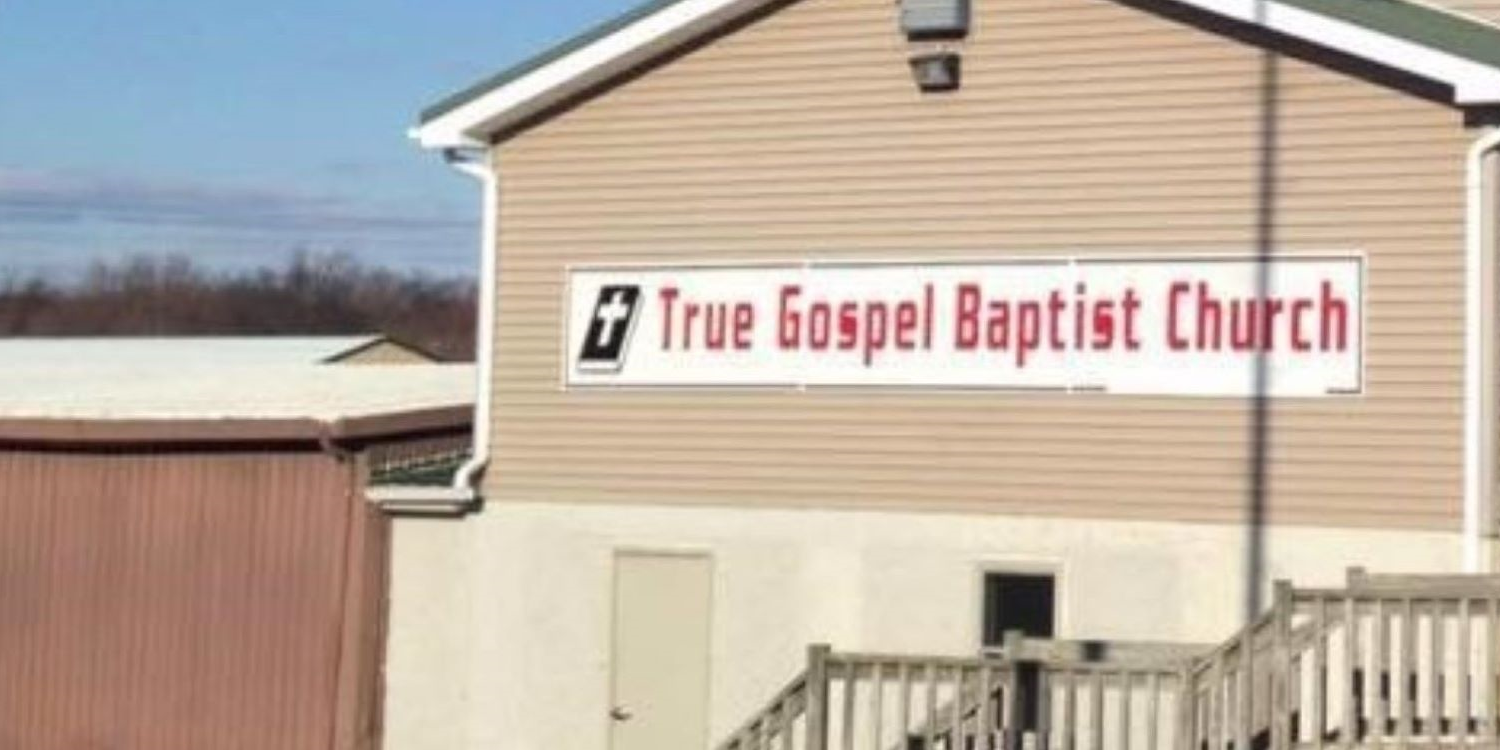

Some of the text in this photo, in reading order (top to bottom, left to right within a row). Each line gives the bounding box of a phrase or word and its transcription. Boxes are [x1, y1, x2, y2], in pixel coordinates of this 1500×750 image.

[658, 280, 1348, 367] True Gospel Baptist Church
